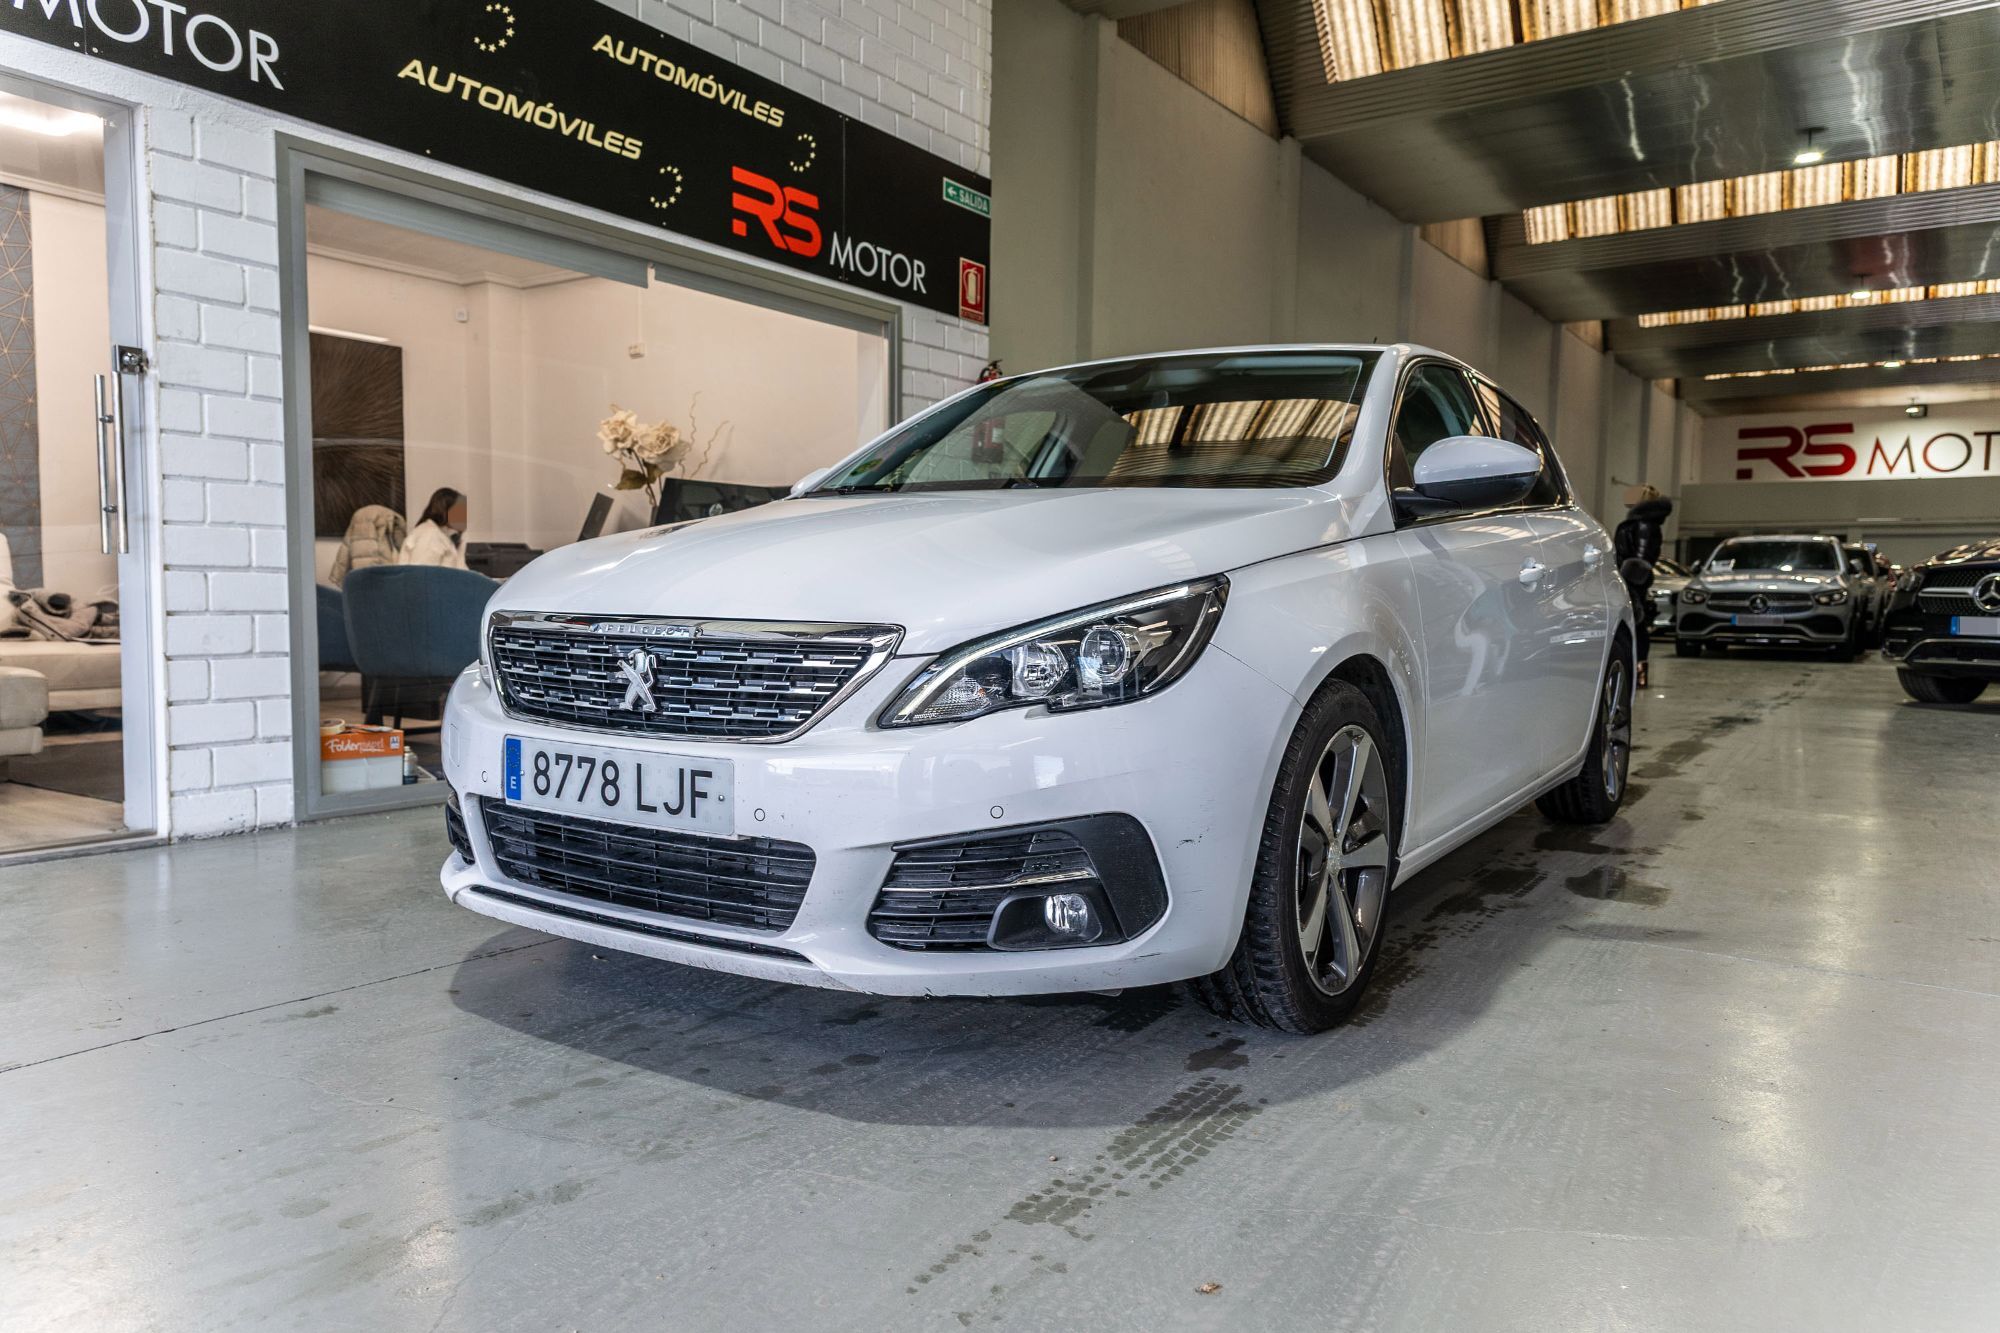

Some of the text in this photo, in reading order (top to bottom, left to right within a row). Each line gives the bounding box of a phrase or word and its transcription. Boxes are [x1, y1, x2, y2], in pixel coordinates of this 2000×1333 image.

[398, 59, 643, 160] AUTOMÓVILES
[592, 34, 785, 128] AUTOMÓVILES
[732, 165, 927, 294] RS MOTOR
[959, 189, 988, 212] SALIDA
[1736, 423, 1857, 480] RS
[605, 624, 690, 637] PEUGEOT
[510, 750, 713, 818] E 8778 LJF
